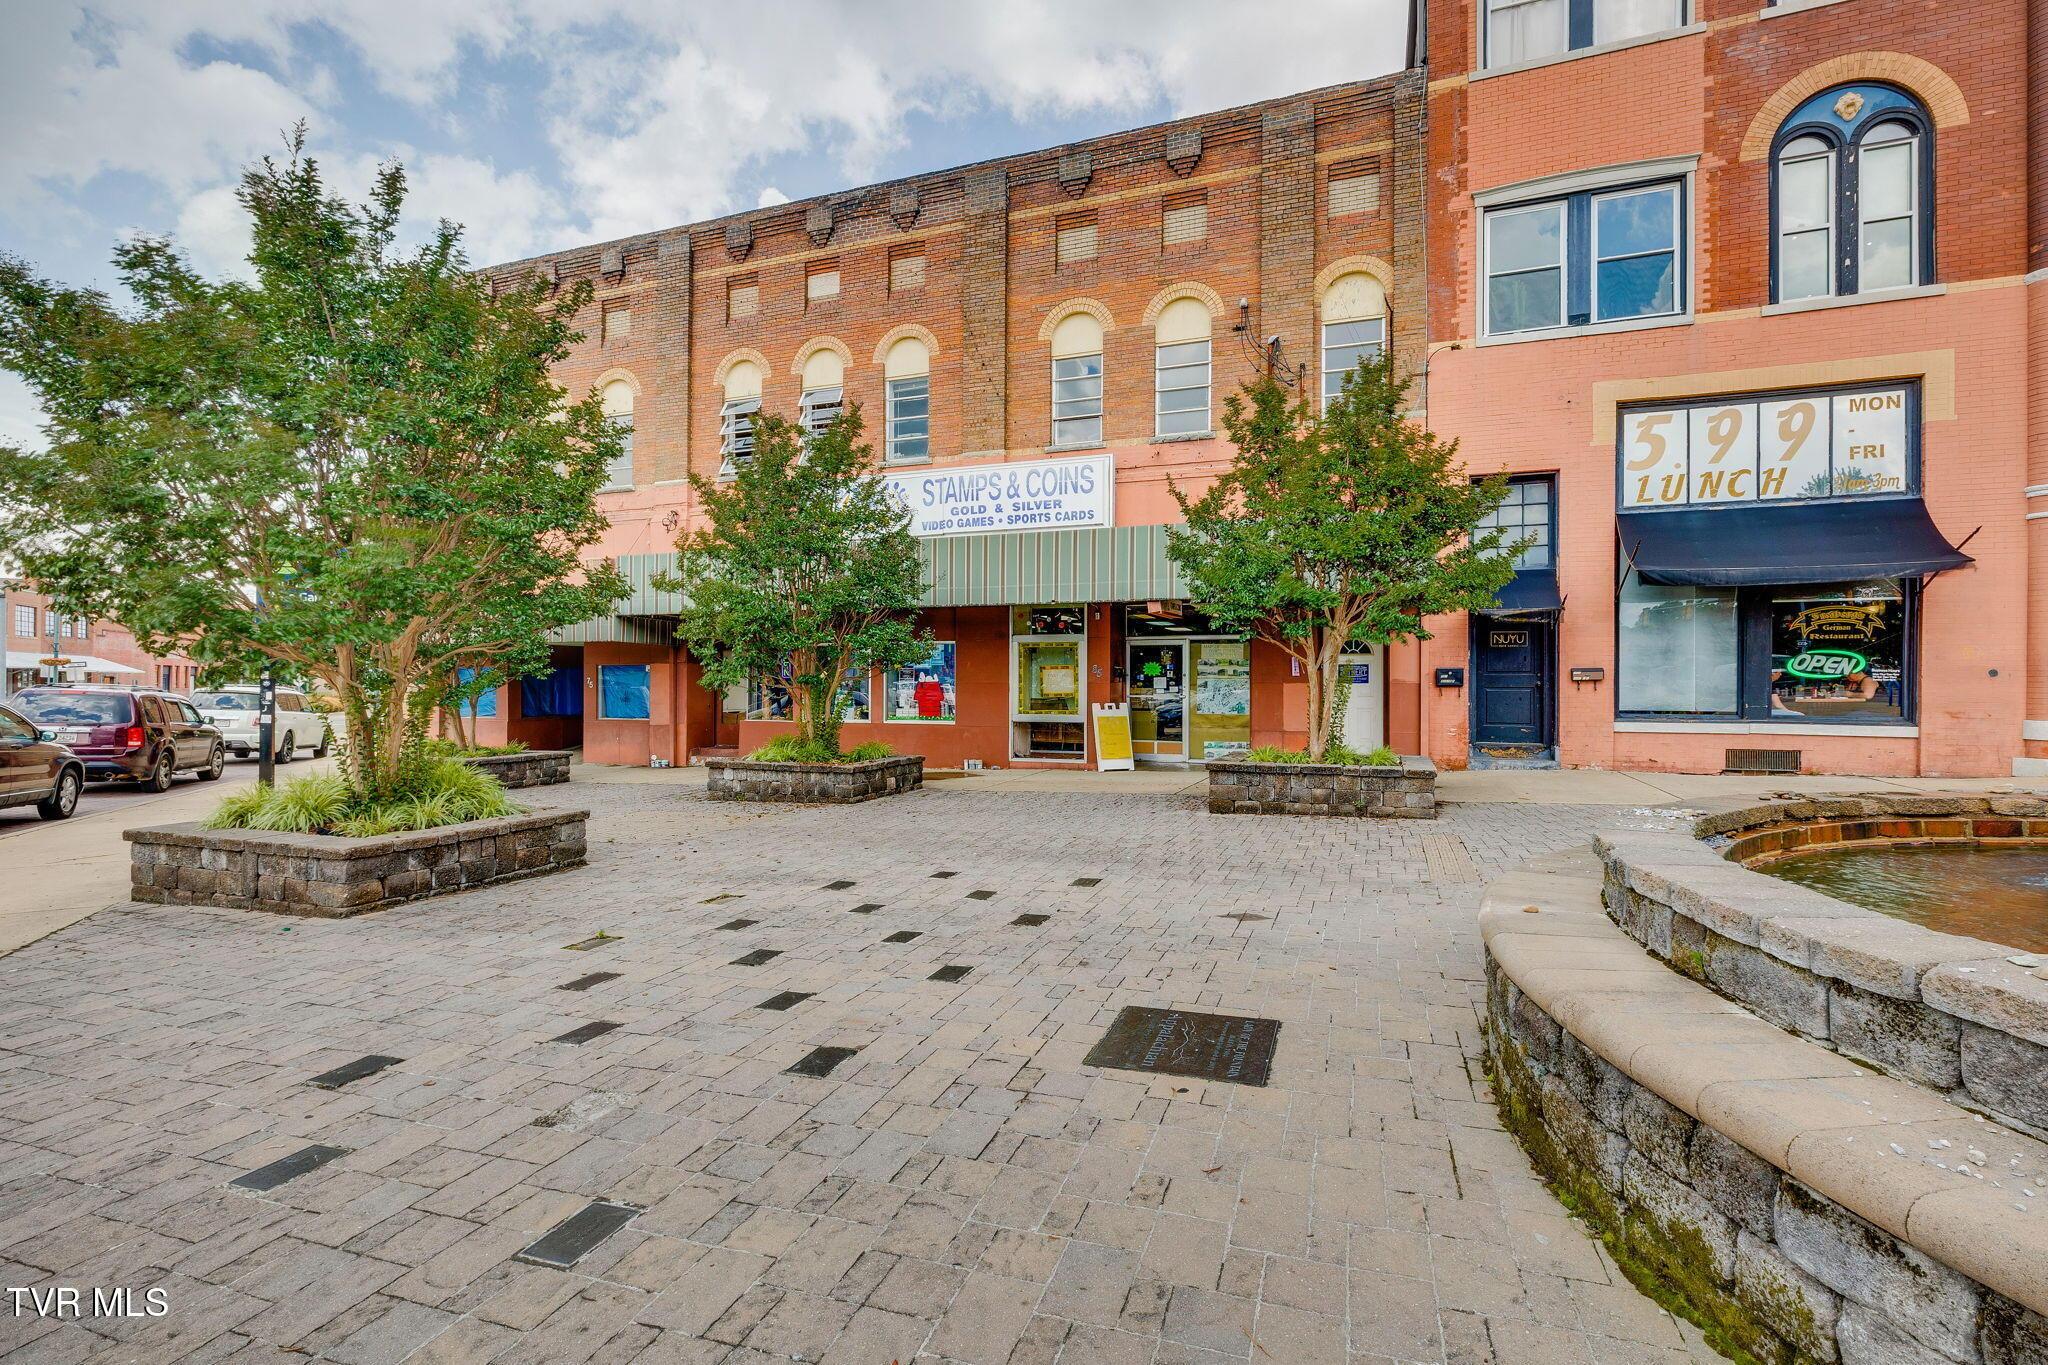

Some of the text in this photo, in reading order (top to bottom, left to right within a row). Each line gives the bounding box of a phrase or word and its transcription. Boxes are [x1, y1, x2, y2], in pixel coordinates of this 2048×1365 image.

[1849, 394, 1902, 413] MON
[1849, 444, 1886, 461] FRI
[922, 464, 1095, 506] STAMPS & COINS
[1636, 467, 1788, 503] LUNCH
[1872, 472, 1900, 491] 3pm
[950, 499, 1063, 516] GOLD & SILVER
[921, 509, 1095, 531] VIDEO GAMES SPORTS CARDS
[1793, 654, 1857, 675] OPEN
[1141, 1013, 1182, 1067] Appalachian
